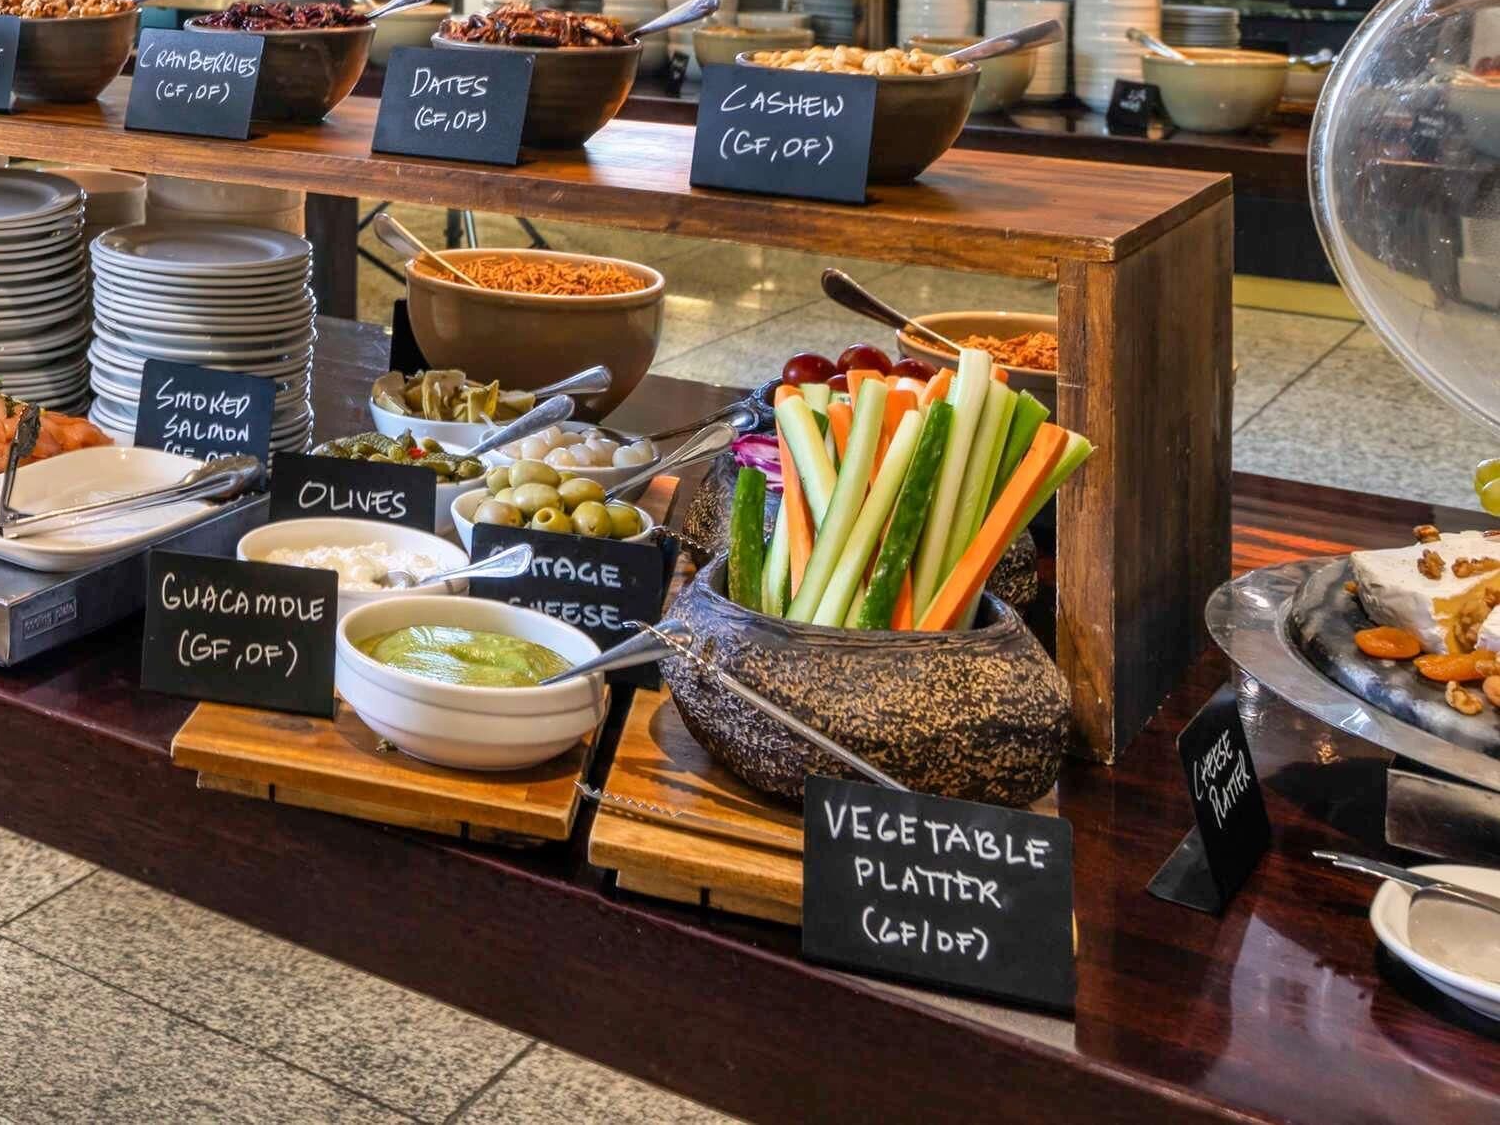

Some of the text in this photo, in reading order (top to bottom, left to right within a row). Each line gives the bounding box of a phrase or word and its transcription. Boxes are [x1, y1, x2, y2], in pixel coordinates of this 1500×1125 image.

[139, 43, 257, 78] CRANBERRIES
[410, 66, 489, 97] DATES
[720, 84, 844, 118] CASHEW
[156, 377, 251, 419] SMOKED
[163, 413, 250, 442] SALMON
[298, 480, 407, 518] OLIVES
[489, 544, 622, 588] TTAGE
[161, 572, 325, 621] GUACAMOLE
[508, 596, 623, 630] EESE
[1193, 729, 1233, 801] CHEESE
[1208, 749, 1251, 830] PLATTER
[824, 800, 1050, 869] VEGETABLE
[854, 856, 1002, 909] PLATTER
